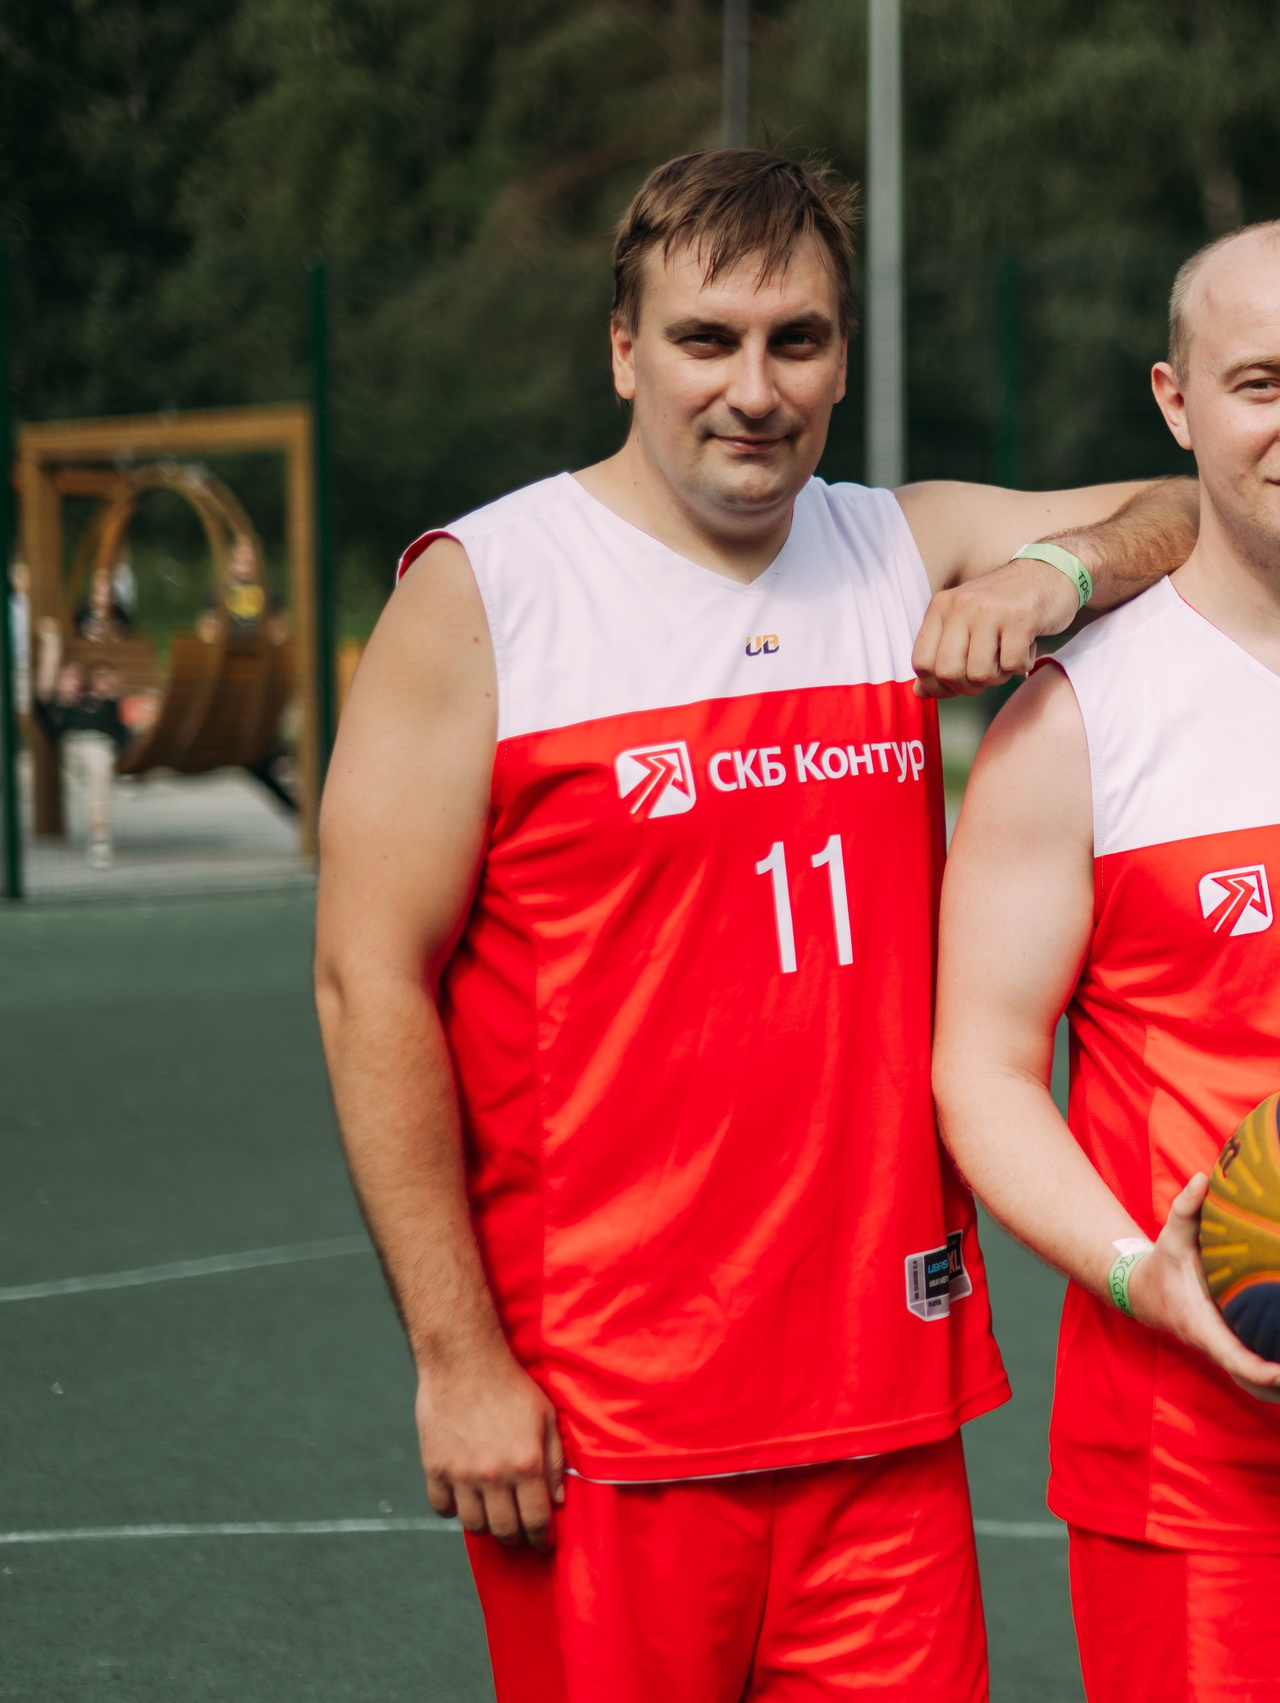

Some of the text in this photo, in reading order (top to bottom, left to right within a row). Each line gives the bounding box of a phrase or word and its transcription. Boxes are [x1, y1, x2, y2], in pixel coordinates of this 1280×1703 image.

[745, 634, 780, 657] UB
[707, 739, 925, 792] СКБ Контур
[755, 834, 854, 974] 11
